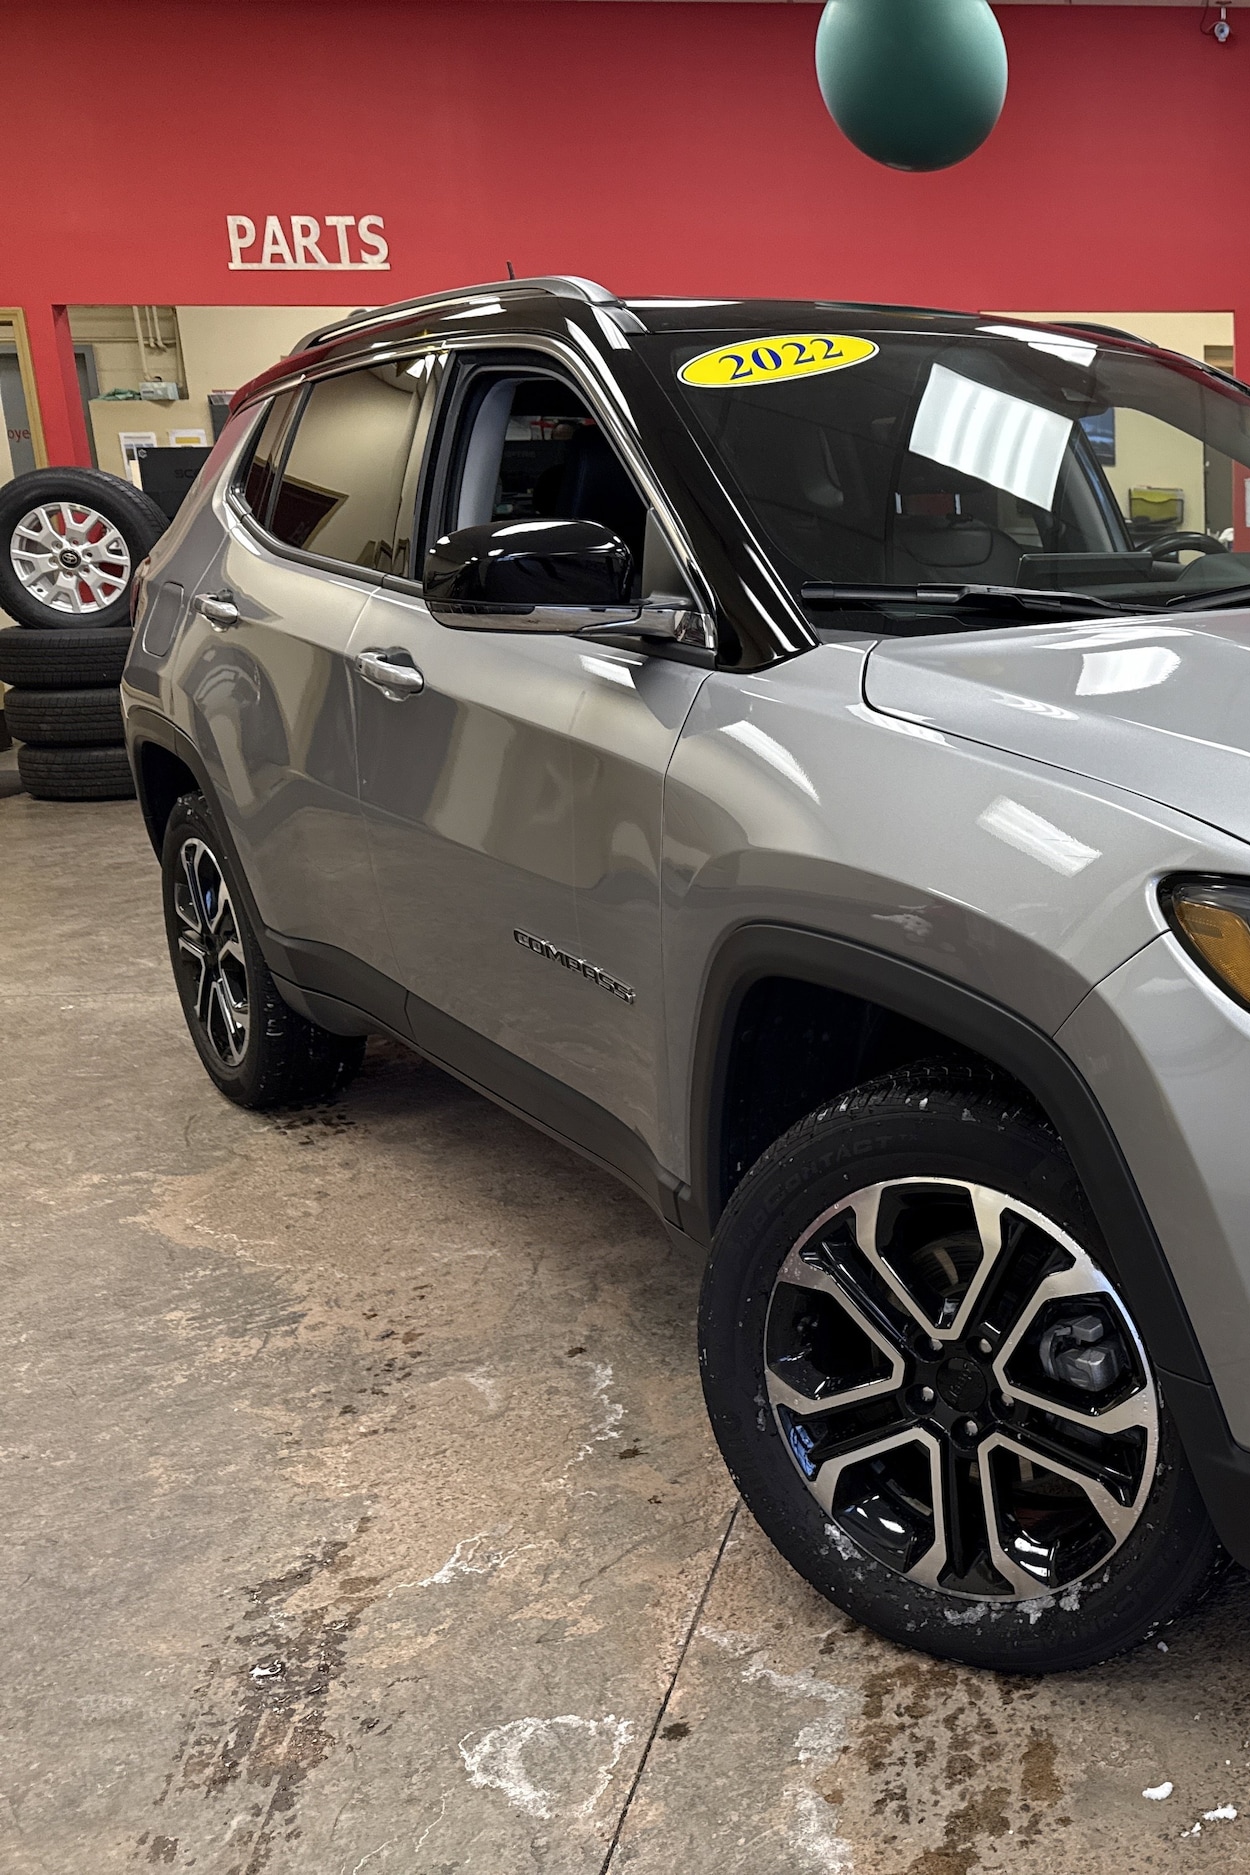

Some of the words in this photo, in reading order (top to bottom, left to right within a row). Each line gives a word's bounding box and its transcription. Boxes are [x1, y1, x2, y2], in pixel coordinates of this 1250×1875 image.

[226, 215, 389, 265] PARTS
[718, 338, 843, 380] 2022
[174, 469, 199, 479] SC
[513, 928, 637, 1005] COMPASS
